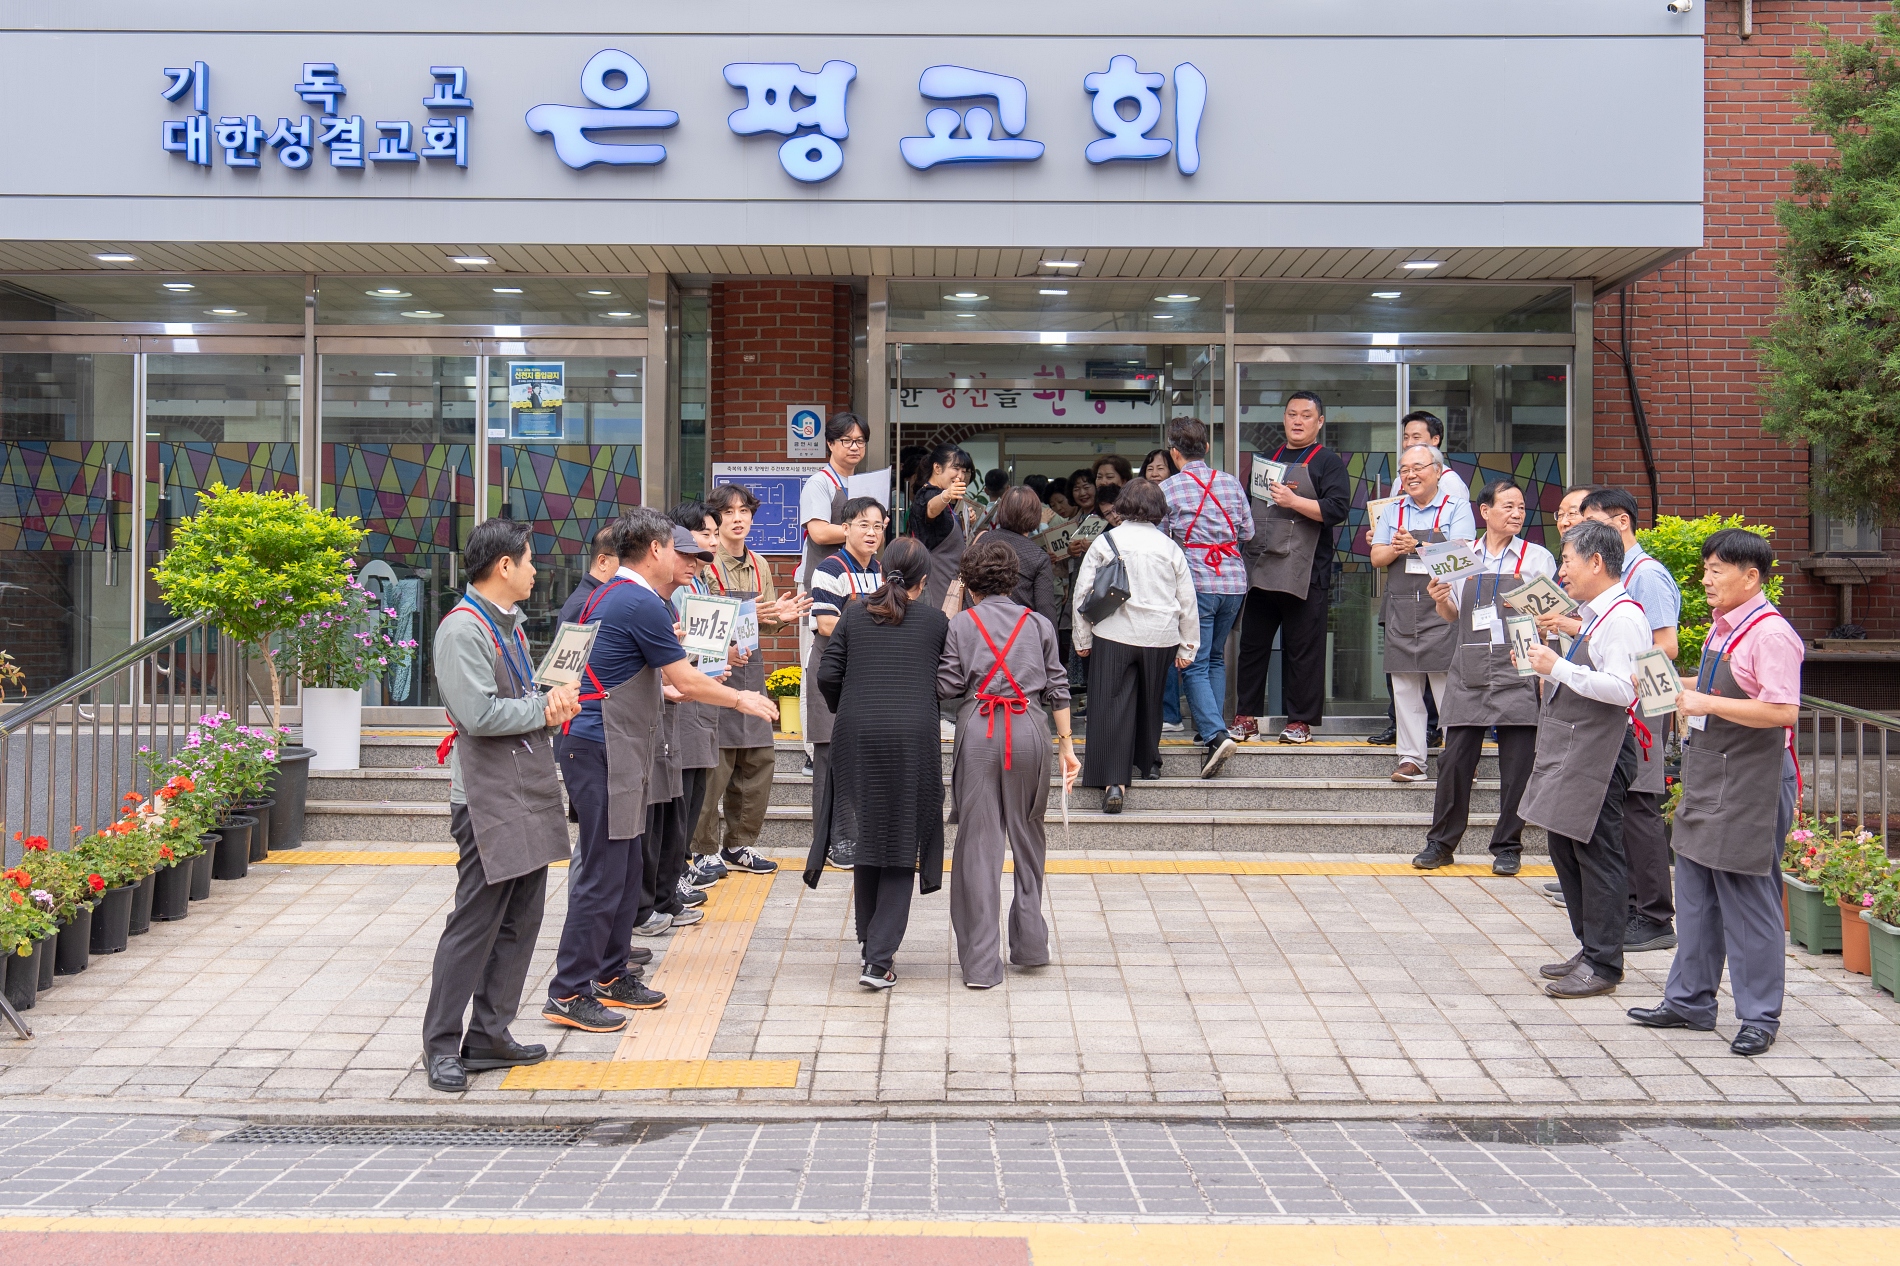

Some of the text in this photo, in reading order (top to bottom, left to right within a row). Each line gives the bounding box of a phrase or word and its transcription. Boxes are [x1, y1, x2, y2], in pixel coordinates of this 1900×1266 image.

[161, 60, 474, 116] 기독교
[525, 48, 1207, 183] 은평교회
[162, 114, 469, 170] 대한성결교회
[1051, 529, 1073, 552] 여자3
[1431, 554, 1474, 576] 남자2조
[688, 609, 729, 640] 남자1조
